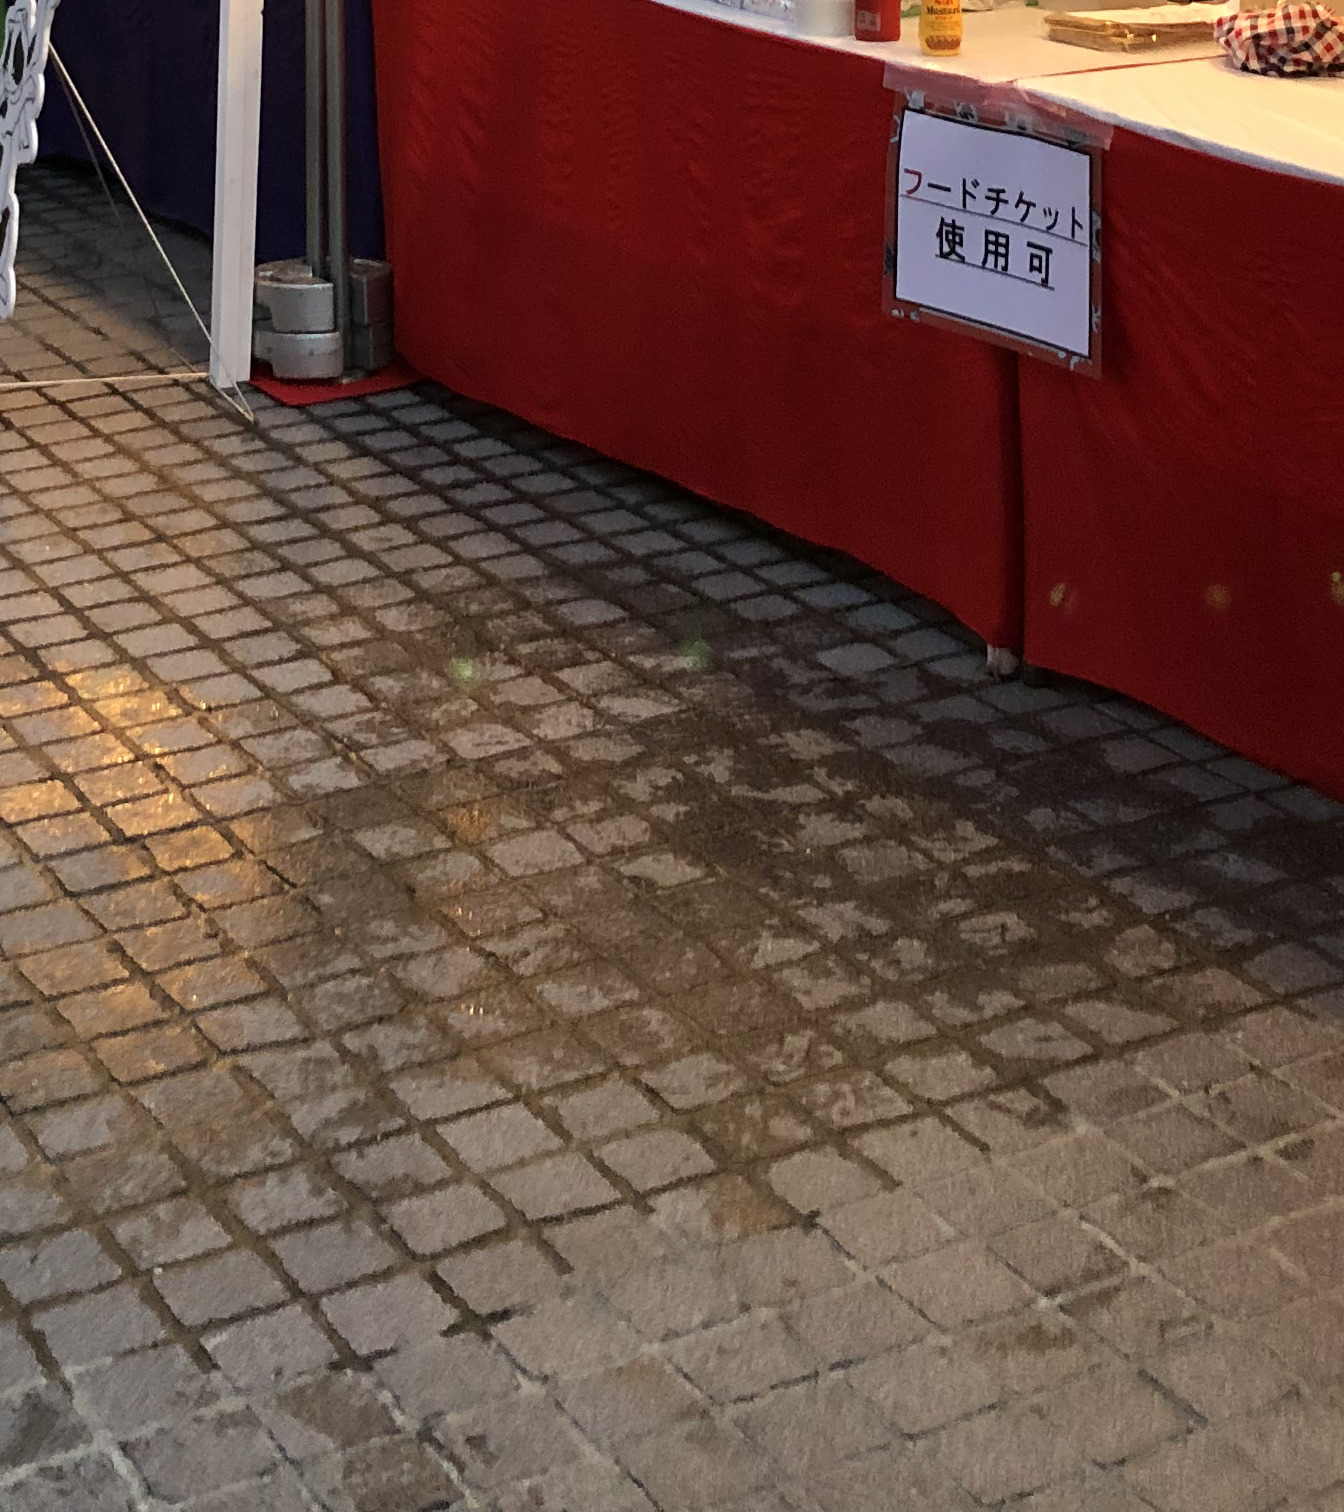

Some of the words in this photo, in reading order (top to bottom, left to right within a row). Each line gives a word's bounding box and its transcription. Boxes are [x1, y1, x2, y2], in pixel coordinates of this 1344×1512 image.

[903, 167, 1084, 239] フードチケット
[935, 216, 1053, 287] 使用可
